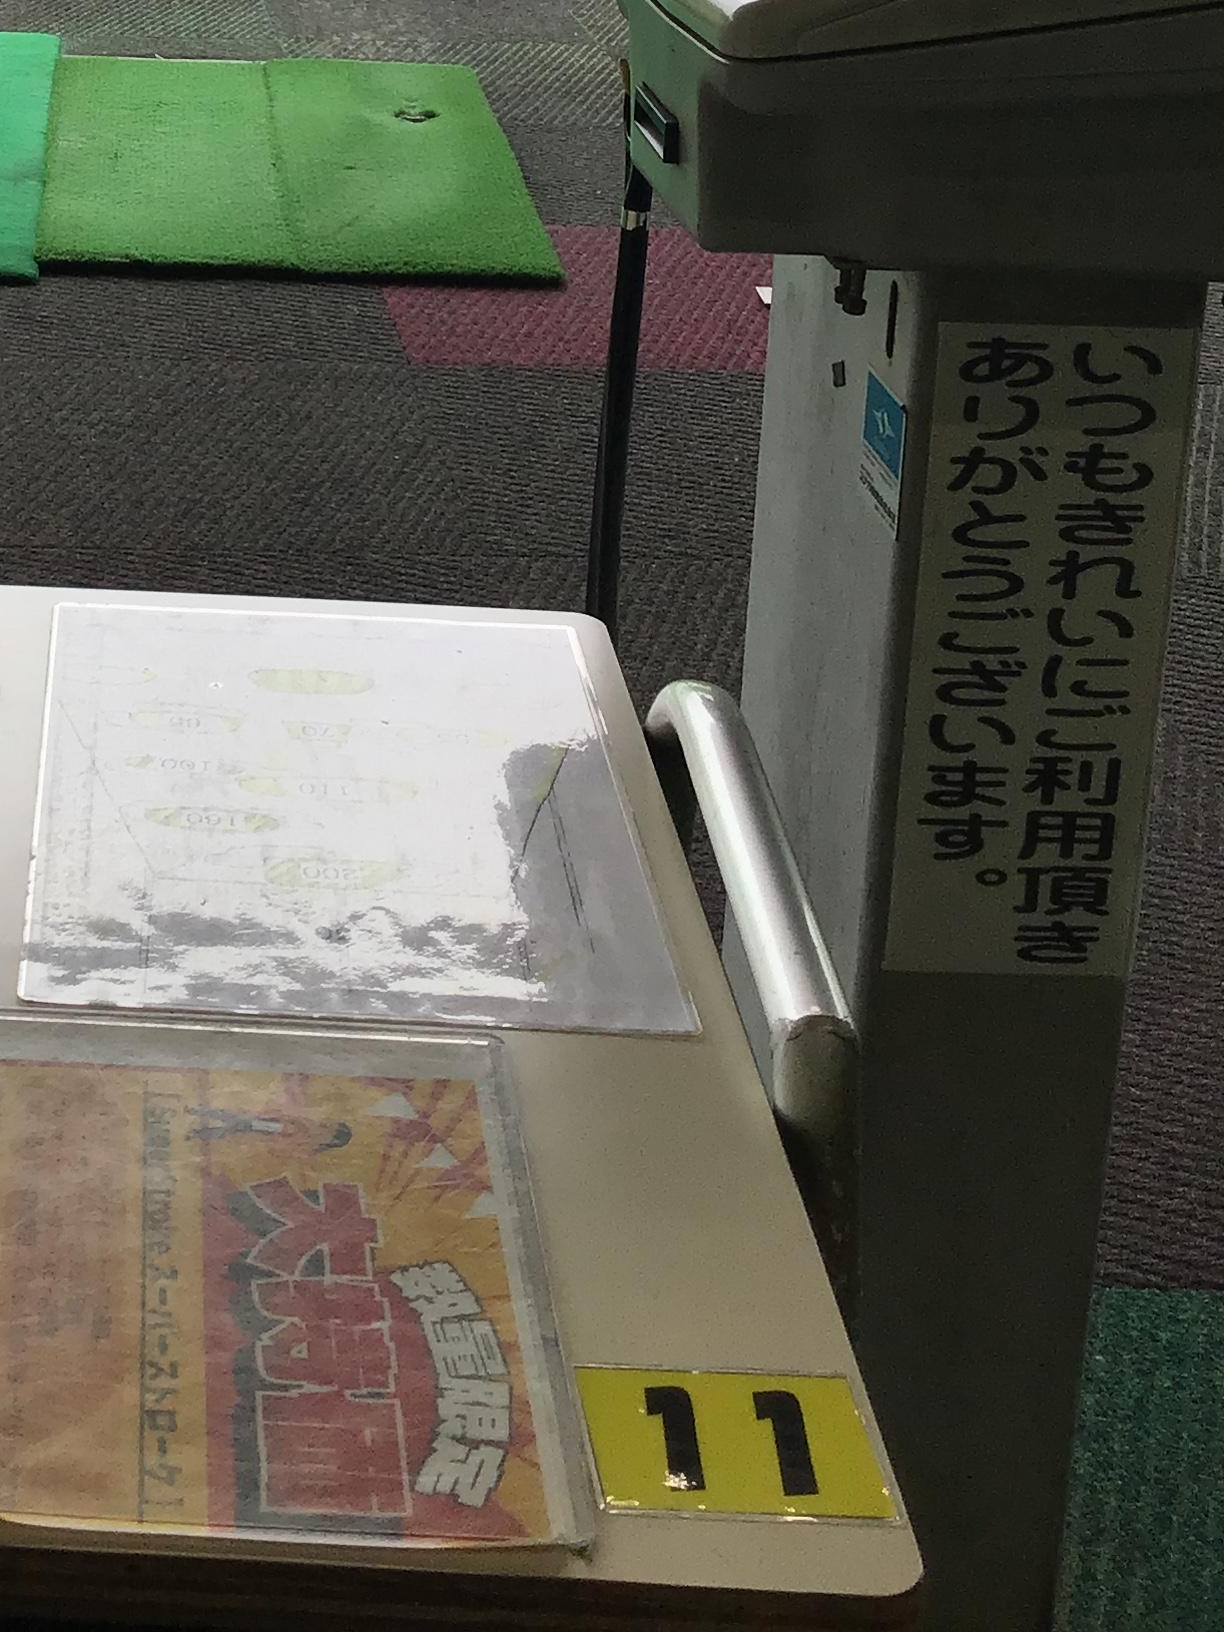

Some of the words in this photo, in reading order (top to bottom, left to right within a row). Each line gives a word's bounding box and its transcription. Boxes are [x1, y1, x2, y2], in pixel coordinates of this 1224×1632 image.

[917, 336, 1055, 889] ありがとうございます。
[1012, 341, 1164, 966] いつもきれいにご利用頂き
[390, 1260, 513, 1510] 数量限定
[643, 1385, 820, 1496] 11
